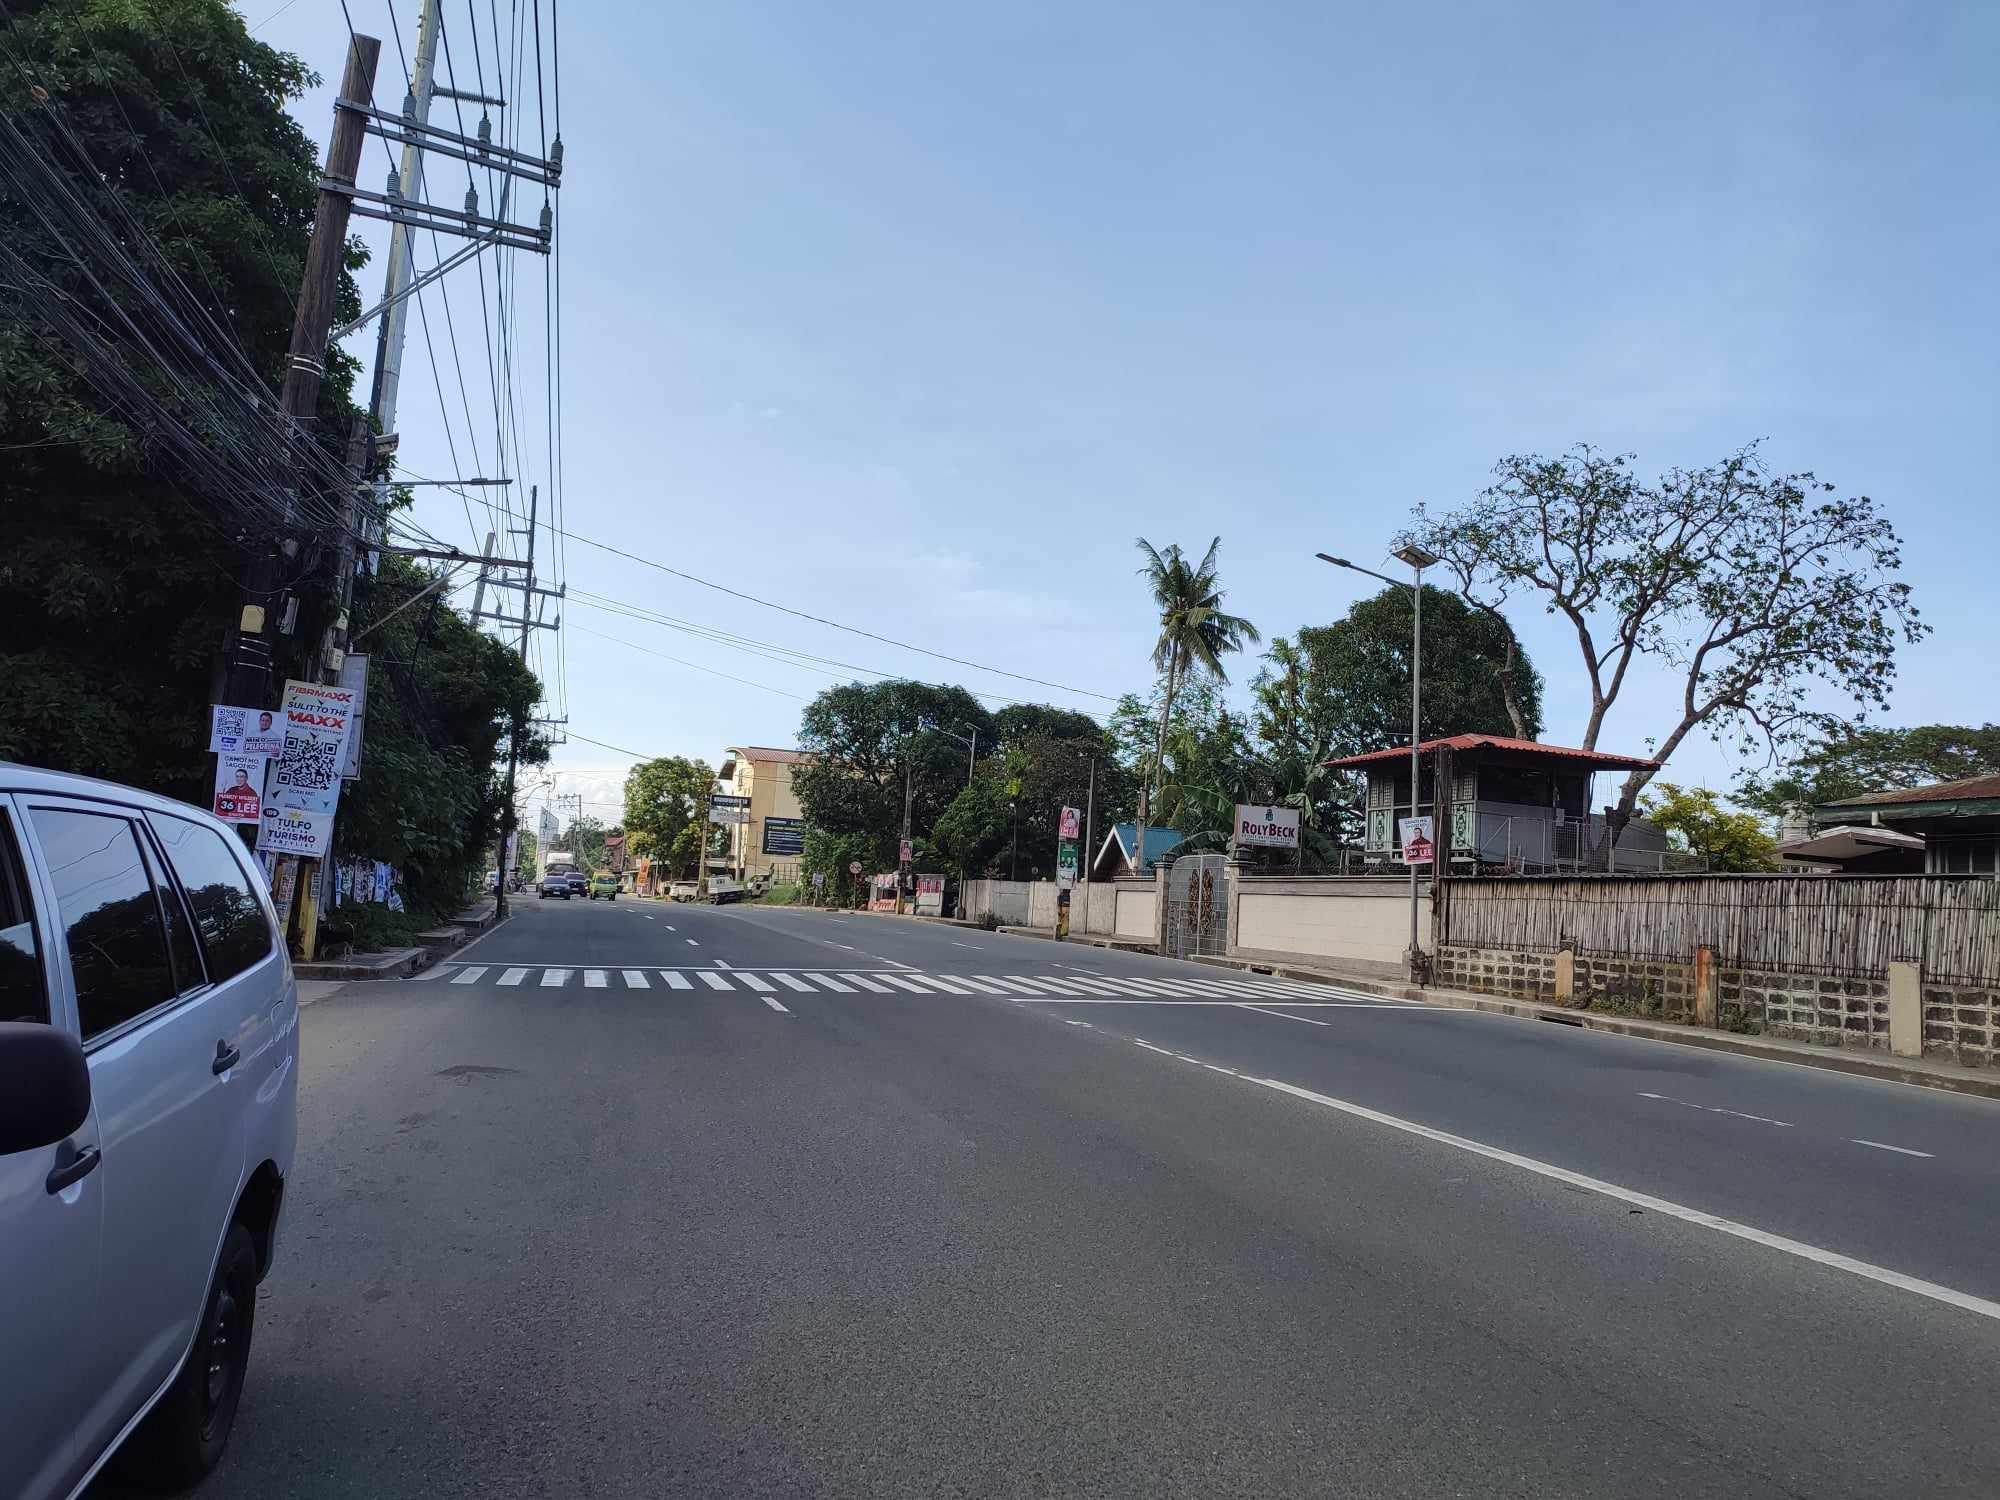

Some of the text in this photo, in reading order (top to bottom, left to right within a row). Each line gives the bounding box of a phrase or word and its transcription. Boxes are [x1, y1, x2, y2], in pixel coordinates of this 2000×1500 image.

[288, 701, 349, 717] SULIT TO THE
[288, 710, 345, 729] MAXX
[220, 800, 257, 814] 36 LEE
[278, 818, 312, 830] TULFO
[268, 829, 316, 843] TURISMO
